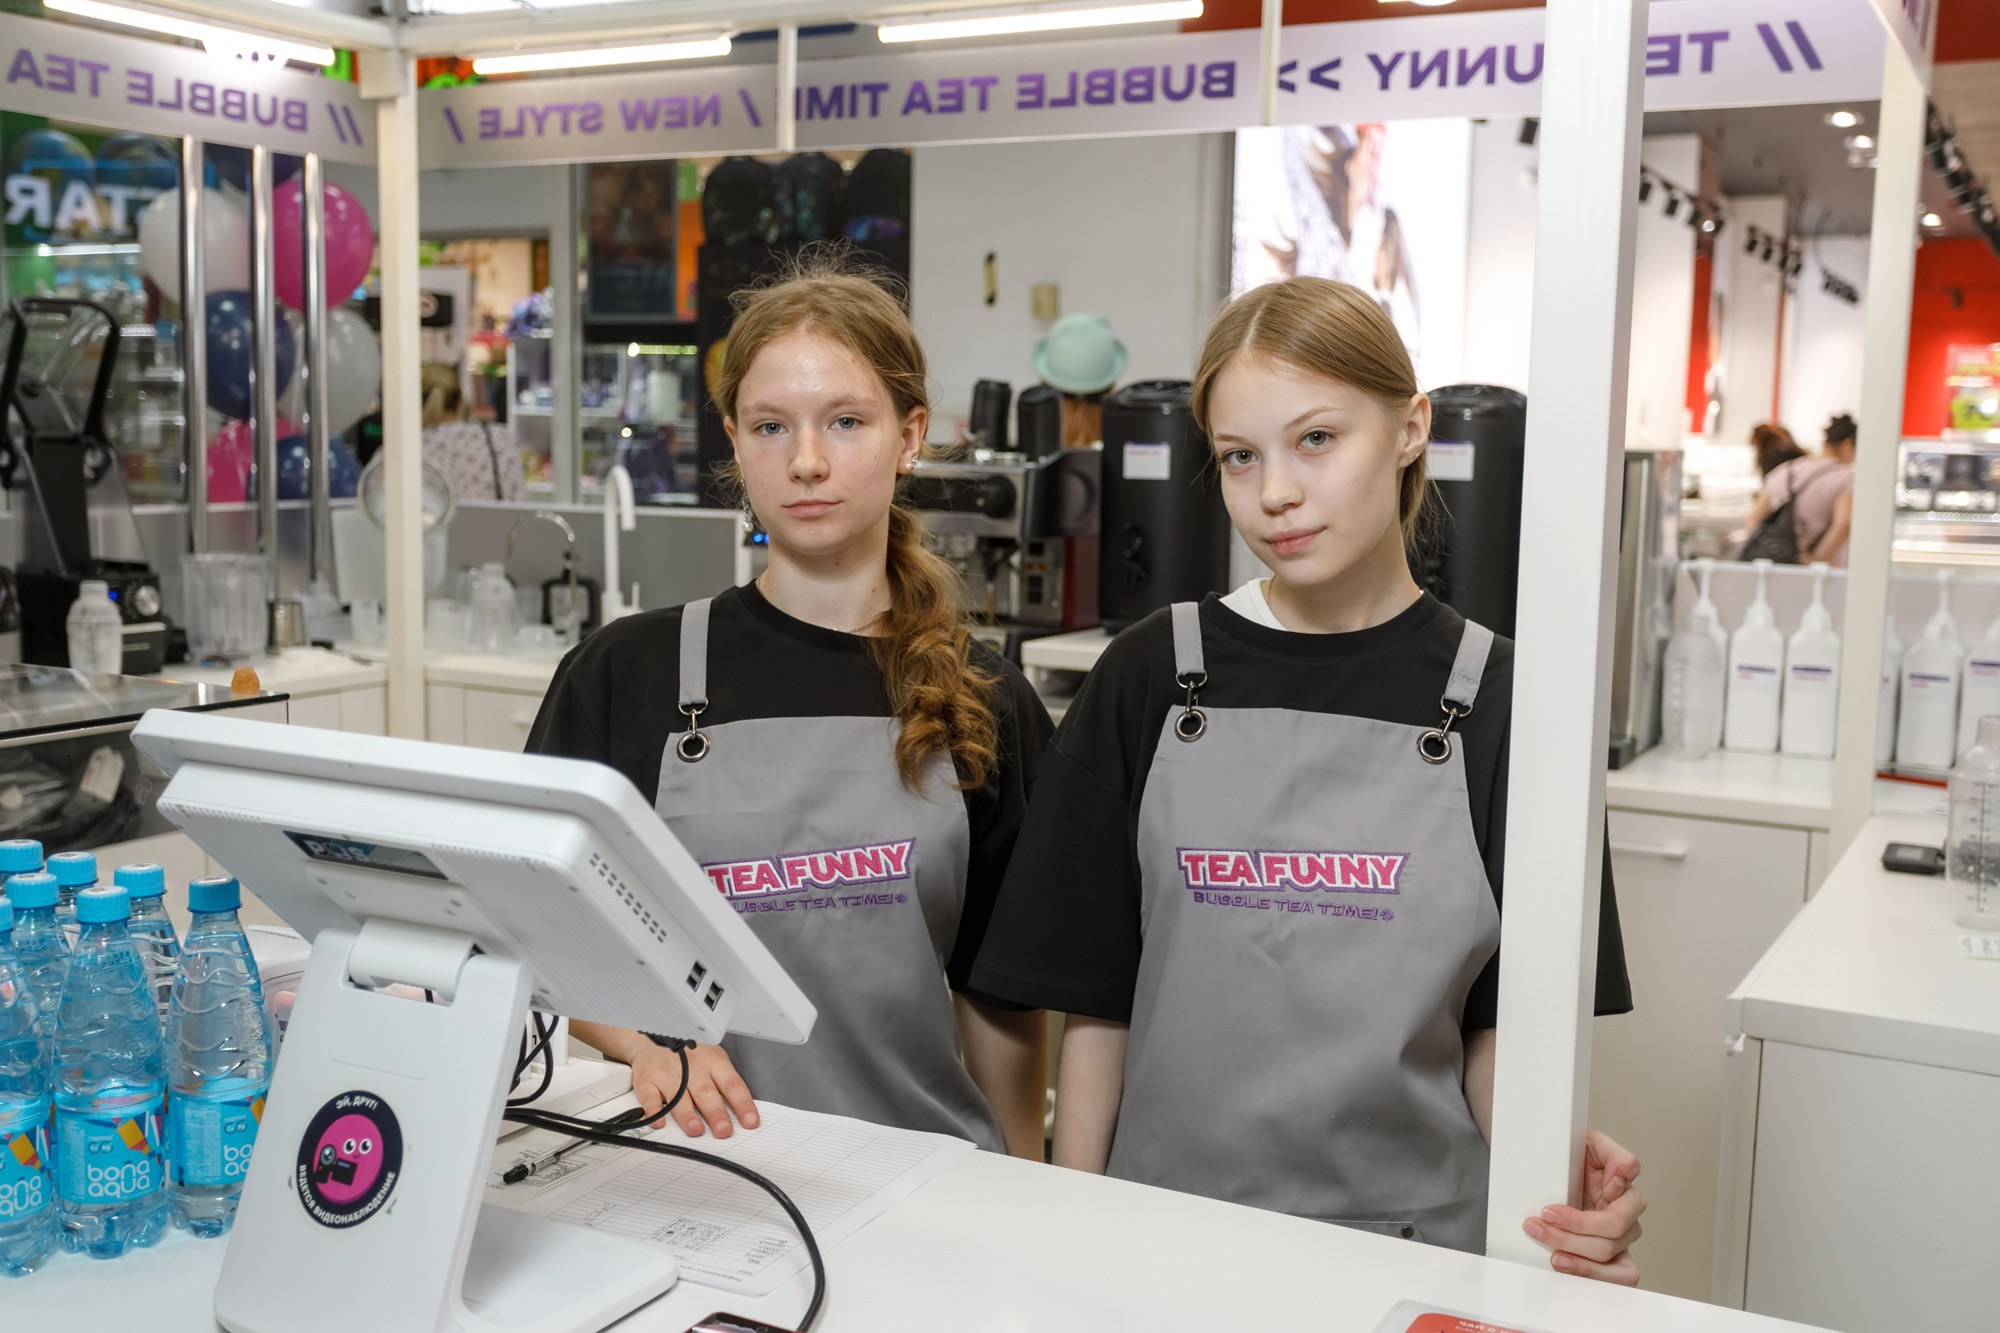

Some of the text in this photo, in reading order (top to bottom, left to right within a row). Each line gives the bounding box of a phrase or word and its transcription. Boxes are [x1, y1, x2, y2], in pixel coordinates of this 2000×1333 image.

[706, 841, 912, 896] TEA FUNNY
[1180, 850, 1404, 890] TEA FUNNY
[730, 900, 796, 914] UBBLE
[799, 898, 836, 910] TEA
[1194, 890, 1378, 921] BUBBLE TEA TIME!
[88, 1175, 150, 1199] aqua
[313, 1171, 396, 1224] ВИДЕОНАБЛЮДЕНИЕ
